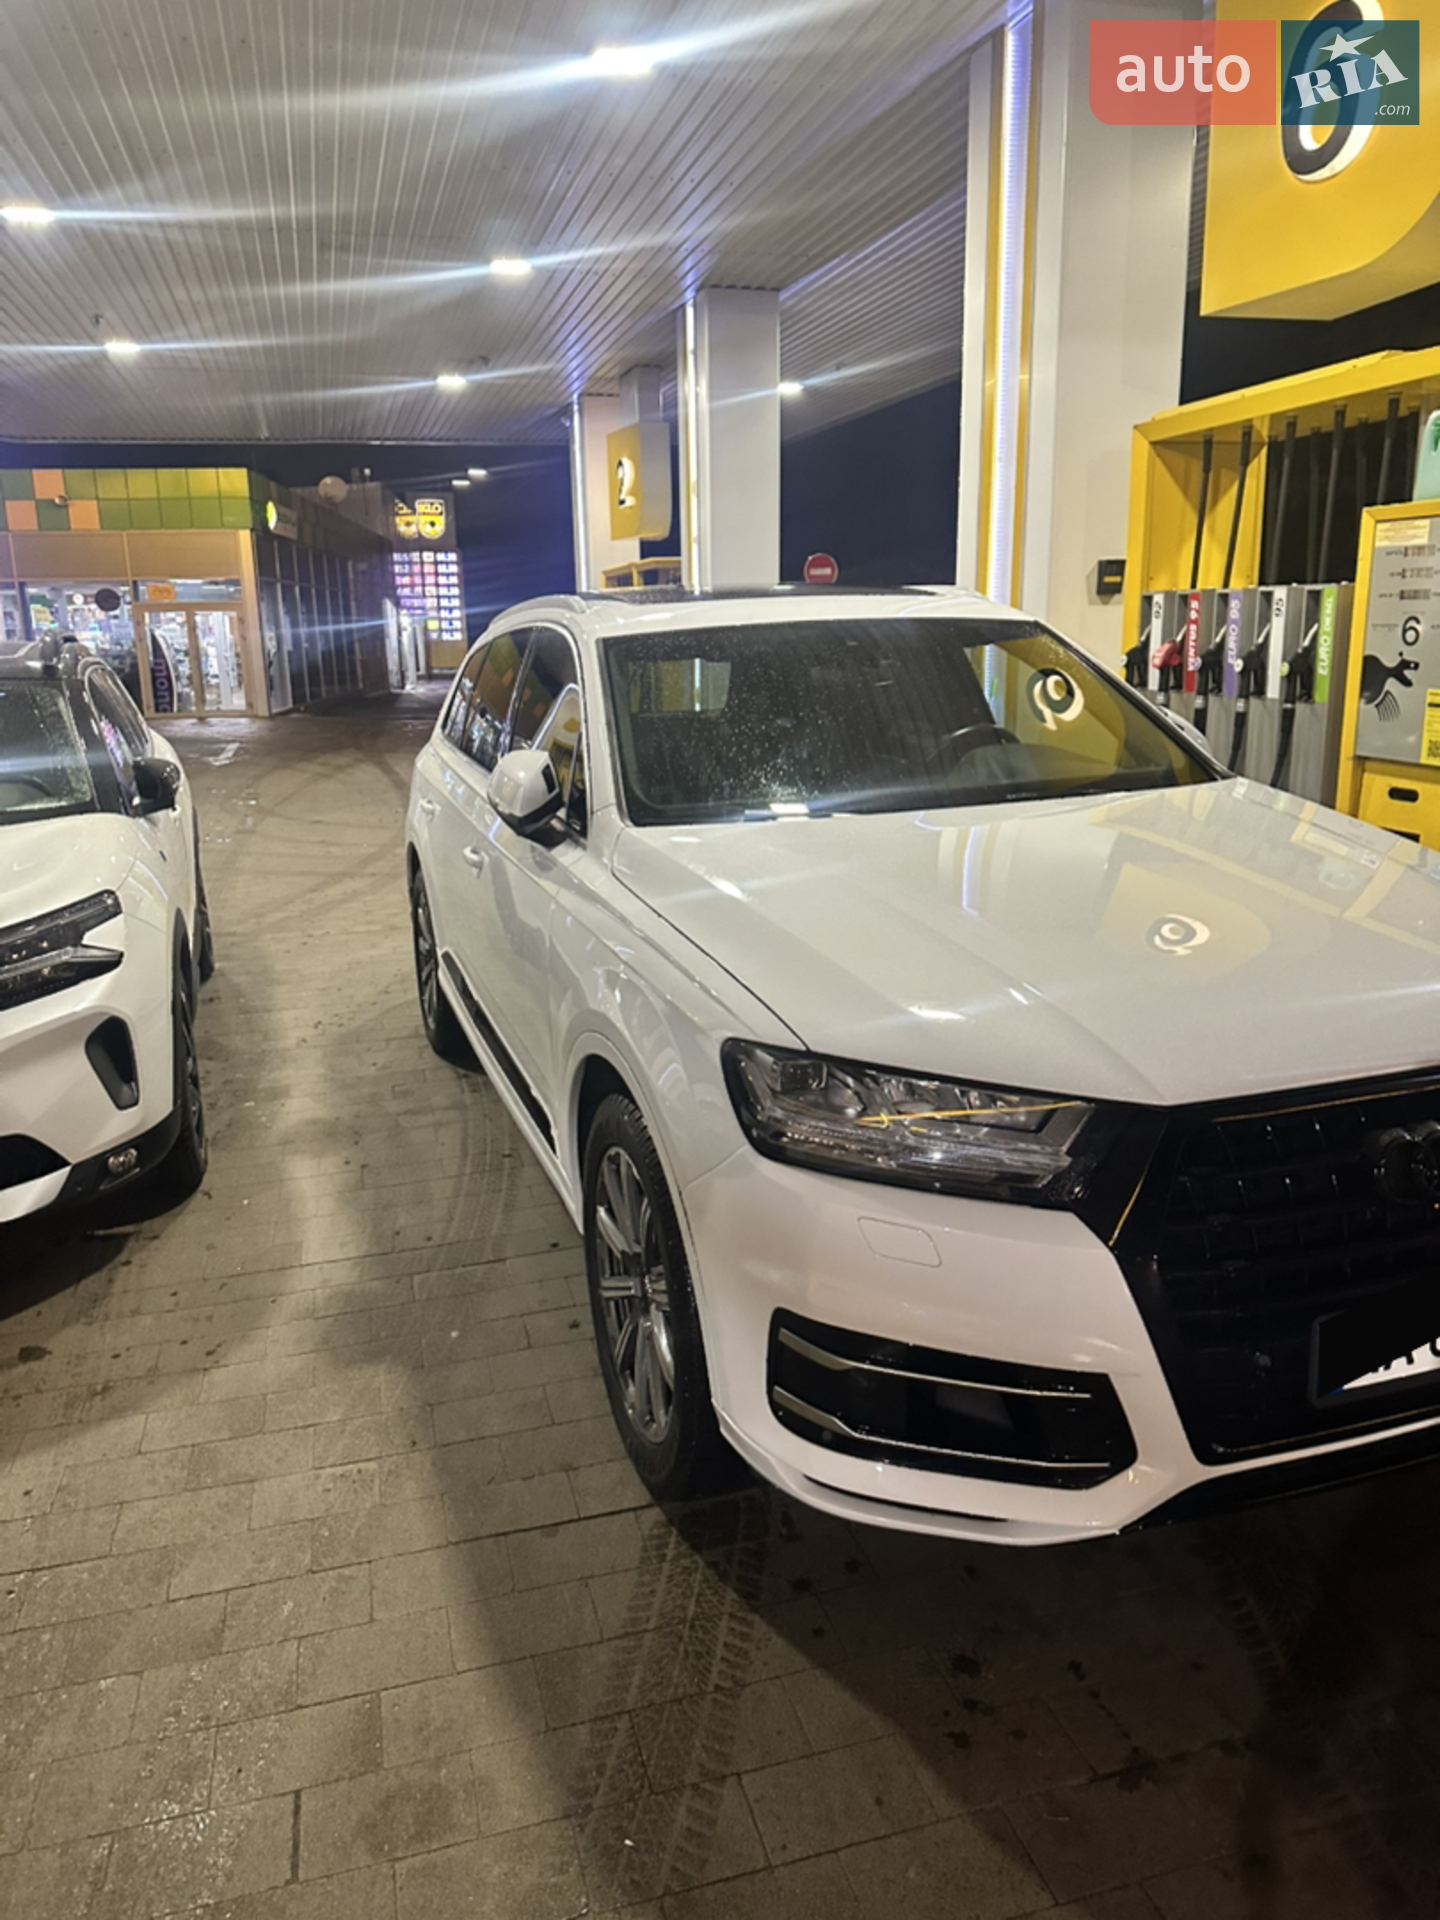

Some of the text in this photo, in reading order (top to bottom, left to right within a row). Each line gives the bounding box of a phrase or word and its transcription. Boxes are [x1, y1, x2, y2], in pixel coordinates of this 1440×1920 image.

[1281, 0, 1384, 184] 6
[616, 456, 637, 509] 2
[1227, 623, 1240, 665] EURO
[1400, 615, 1422, 647] 6
[1318, 635, 1331, 676] EURO
